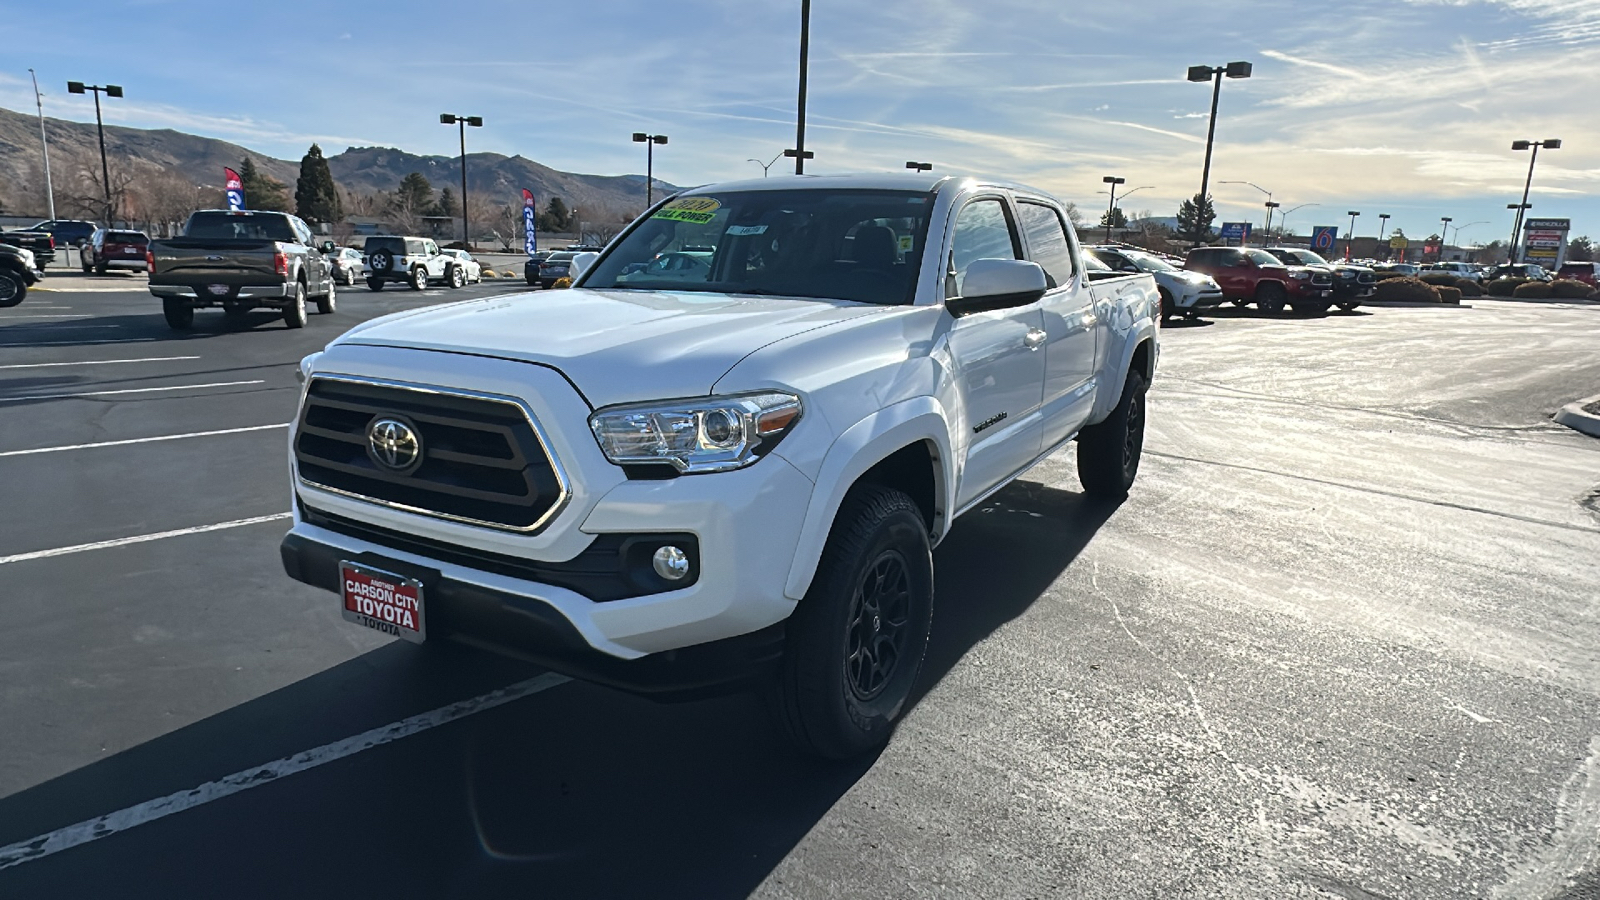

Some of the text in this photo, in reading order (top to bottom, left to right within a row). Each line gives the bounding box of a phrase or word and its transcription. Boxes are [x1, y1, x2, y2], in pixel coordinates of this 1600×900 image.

[653, 209, 713, 222] FULL POWER
[1315, 227, 1333, 250] 6
[345, 579, 419, 612] CARSON CITY
[370, 579, 395, 591] ANOTHER
[354, 595, 414, 629] TOYOTA
[363, 616, 401, 637] TOYOTA
